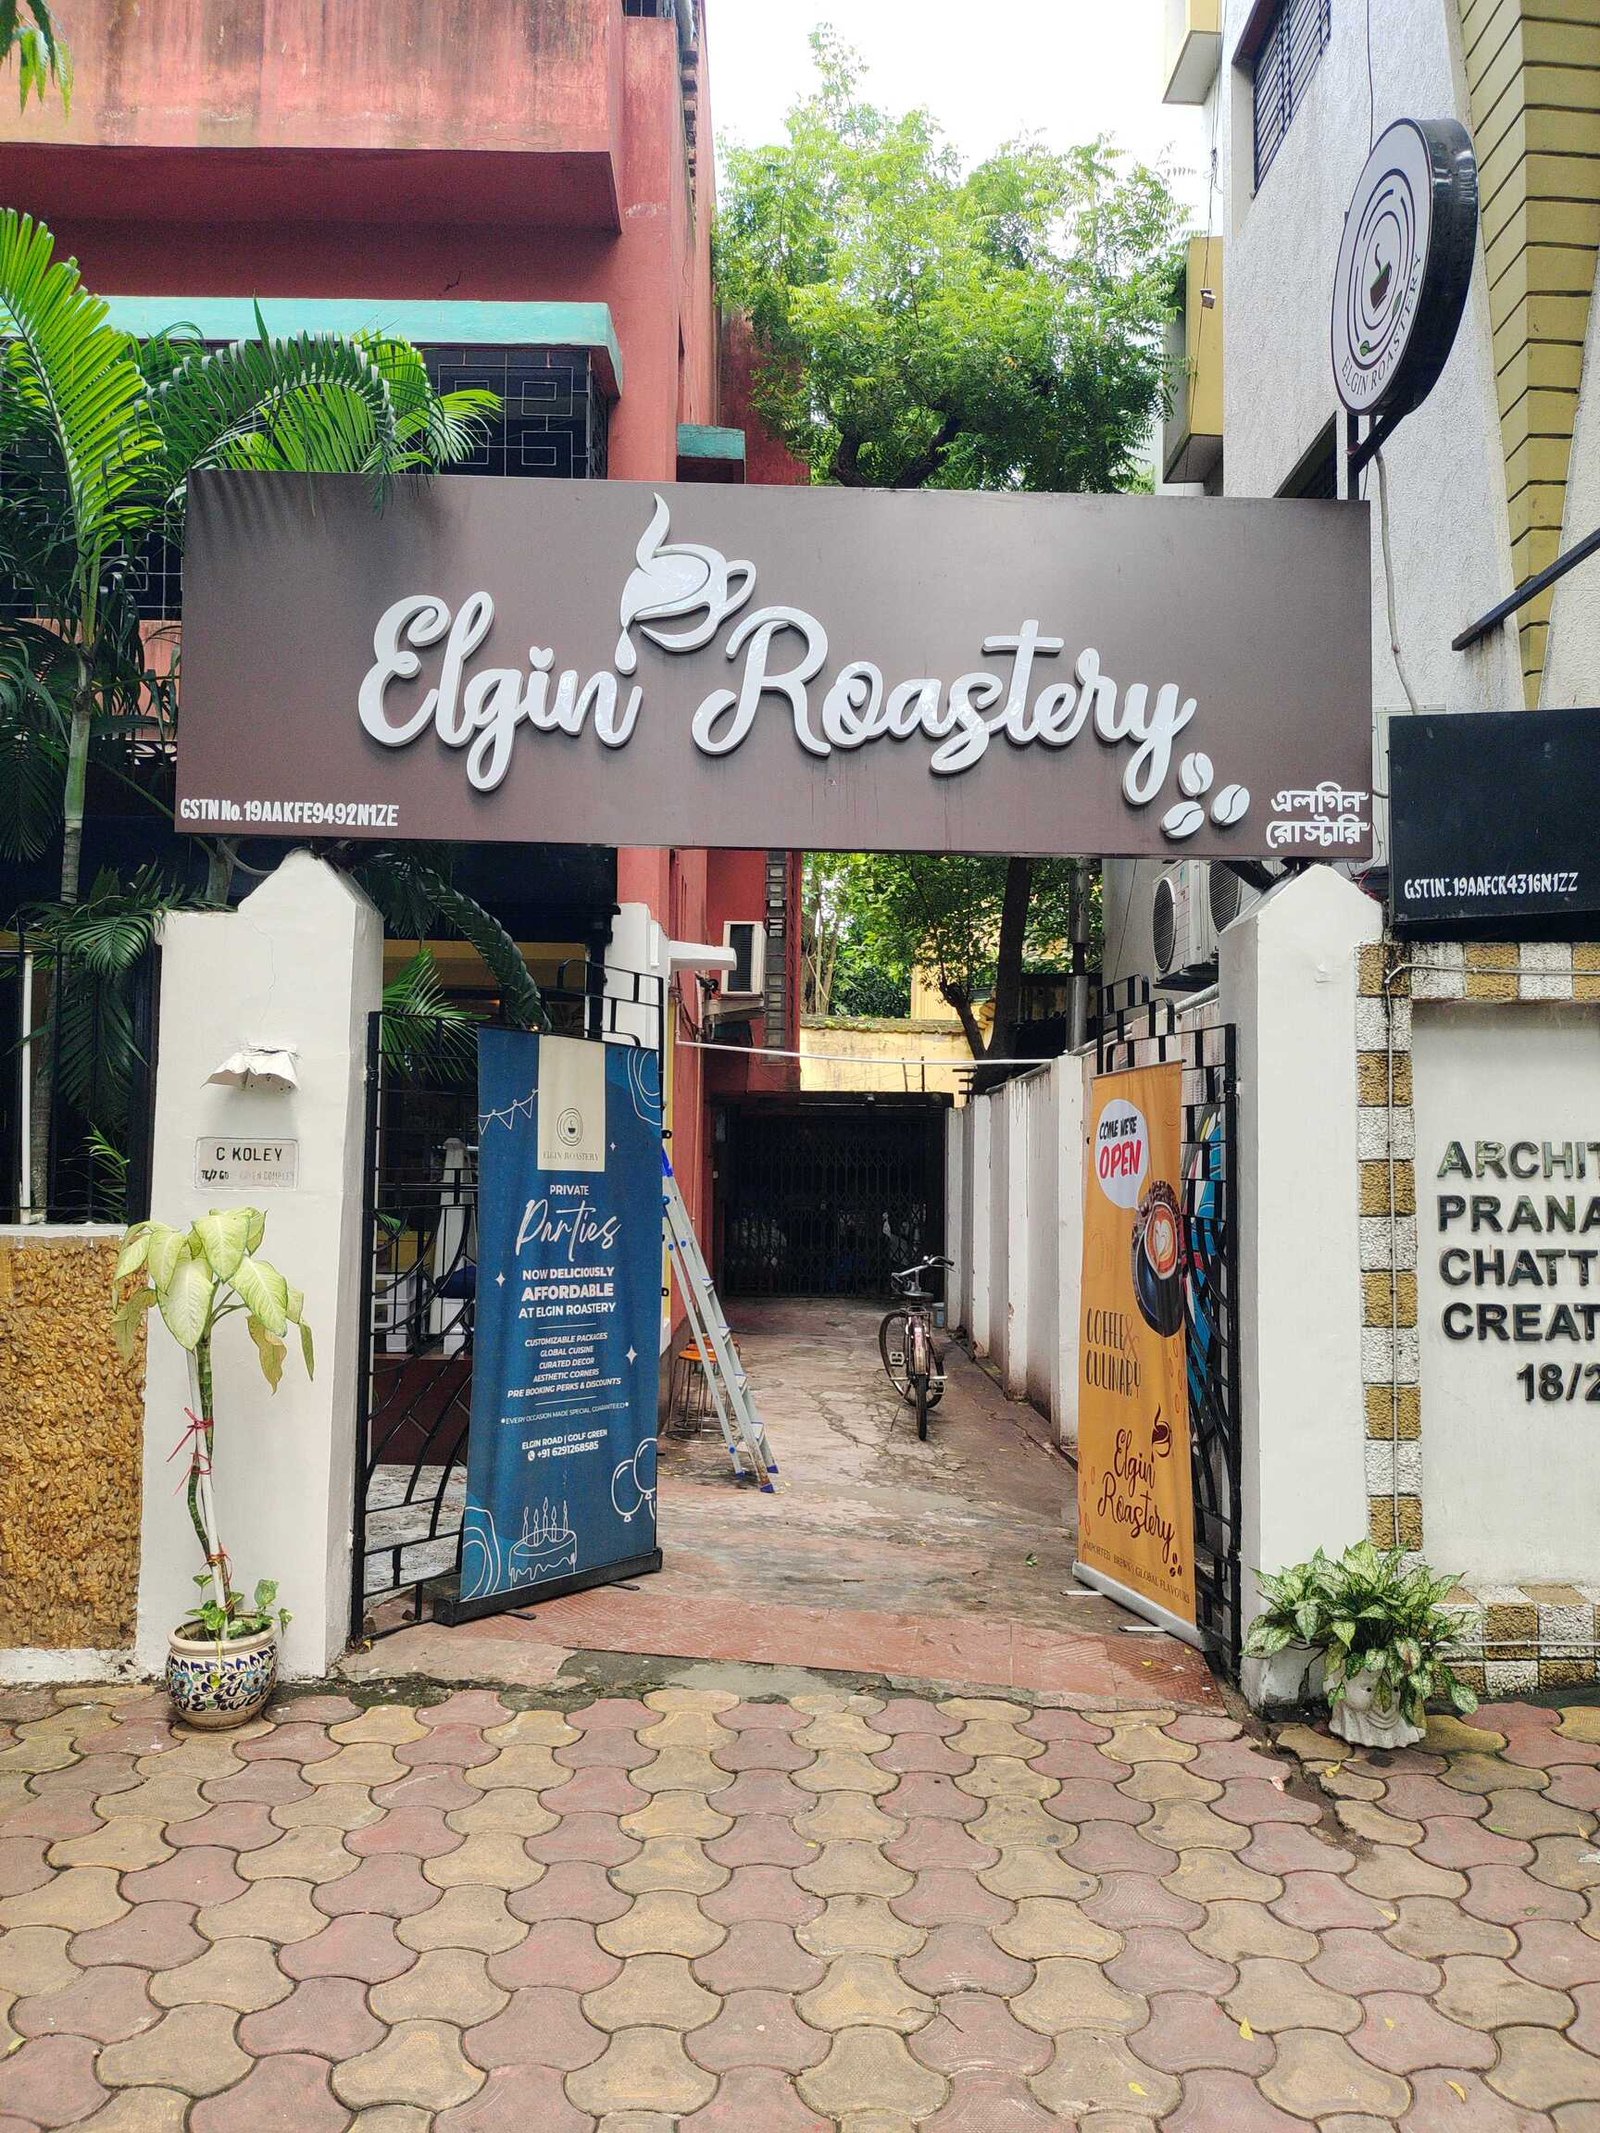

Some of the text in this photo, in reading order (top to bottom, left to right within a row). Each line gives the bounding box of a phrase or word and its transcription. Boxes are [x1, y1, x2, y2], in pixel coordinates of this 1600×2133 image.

[1342, 254, 1421, 395] ELGIN ROASTERY
[358, 590, 1198, 807] Elgin Roastery
[1270, 781, 1369, 813] এলগিন
[180, 798, 219, 820] GSTN
[1265, 813, 1371, 849] রোস্টারি
[1099, 1119, 1118, 1140] COME
[216, 1147, 282, 1161] C KOLEY
[1099, 1139, 1142, 1179] OPEN
[550, 1184, 589, 1196] PRIVATE
[1437, 1194, 1600, 1233] PRANA
[515, 1199, 621, 1262] Parties
[523, 1266, 615, 1280] NOW DELICIOUSLY
[1439, 1247, 1598, 1286] CHATT
[521, 1282, 614, 1302] AFFORDABLE
[518, 1302, 616, 1319] AT ELGIN ROASTERY
[1086, 1307, 1124, 1351] COFFEE
[1441, 1302, 1600, 1341] CREAT
[525, 1332, 608, 1347] CUSTOMIZABLE PACKAGES
[540, 1345, 594, 1357] GLOBAL CUISINE
[539, 1357, 595, 1370] CURATED DECOR
[533, 1368, 599, 1383] AESTHETIC CORNERS
[507, 1389, 524, 1398] PRE
[525, 1386, 555, 1396] BOOKING
[556, 1383, 579, 1392] PERKS
[586, 1378, 622, 1389] DISCOUNTS
[506, 1415, 525, 1425] EVERY
[522, 1440, 541, 1450] ELGIN
[542, 1436, 563, 1446] ROAD
[568, 1432, 586, 1442] GOLF
[587, 1429, 608, 1439] GREEN
[537, 1448, 550, 1458] +91
[1114, 1429, 1155, 1498] Elgin
[1098, 1471, 1175, 1564] Roastery
